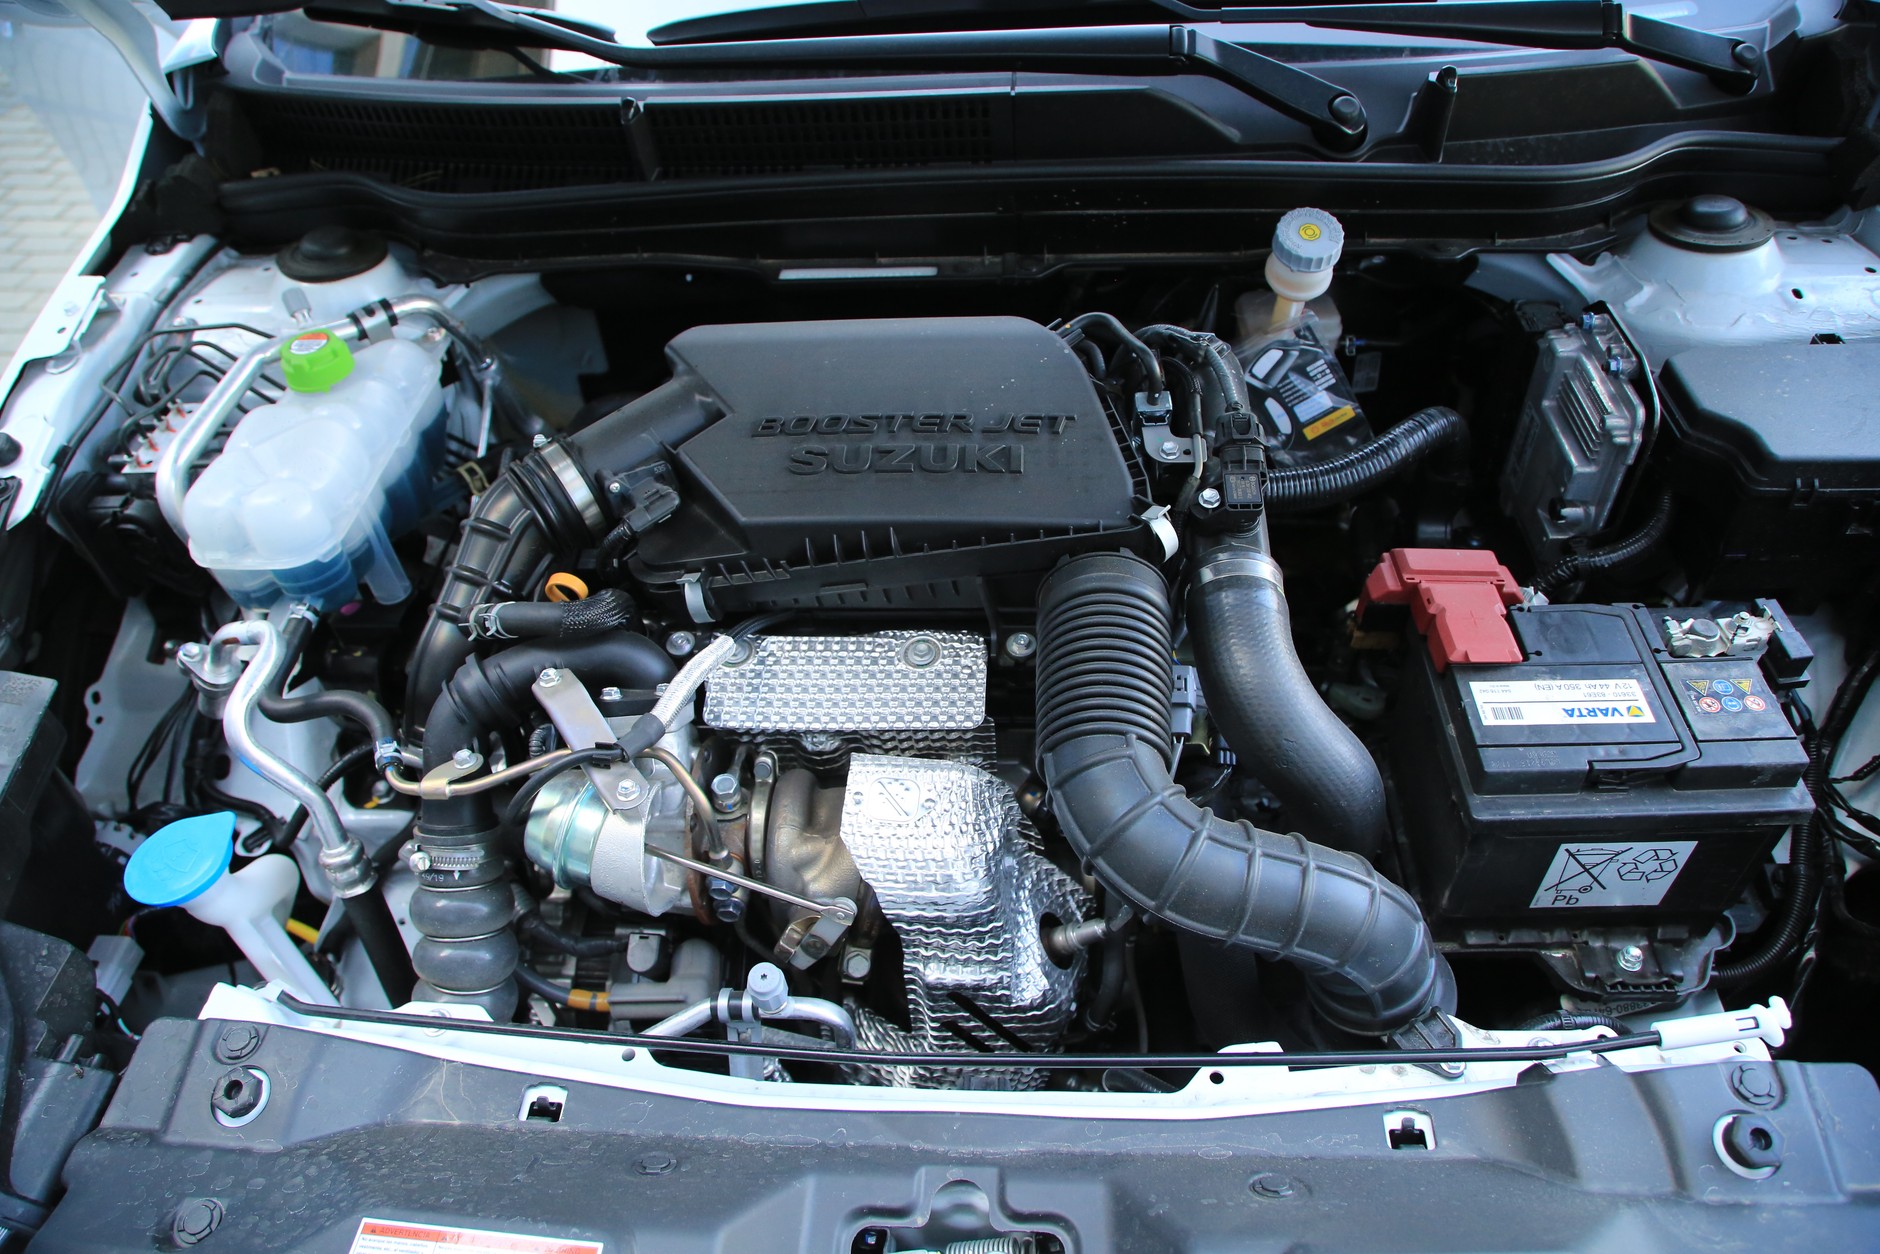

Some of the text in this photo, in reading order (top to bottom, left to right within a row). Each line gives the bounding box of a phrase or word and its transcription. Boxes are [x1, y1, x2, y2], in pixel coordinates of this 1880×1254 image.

[752, 411, 1077, 437] BOOSTER JET
[788, 444, 1025, 475] SUZUKI
[1562, 707, 1624, 718] VARTA
[1551, 894, 1580, 905] Pb
